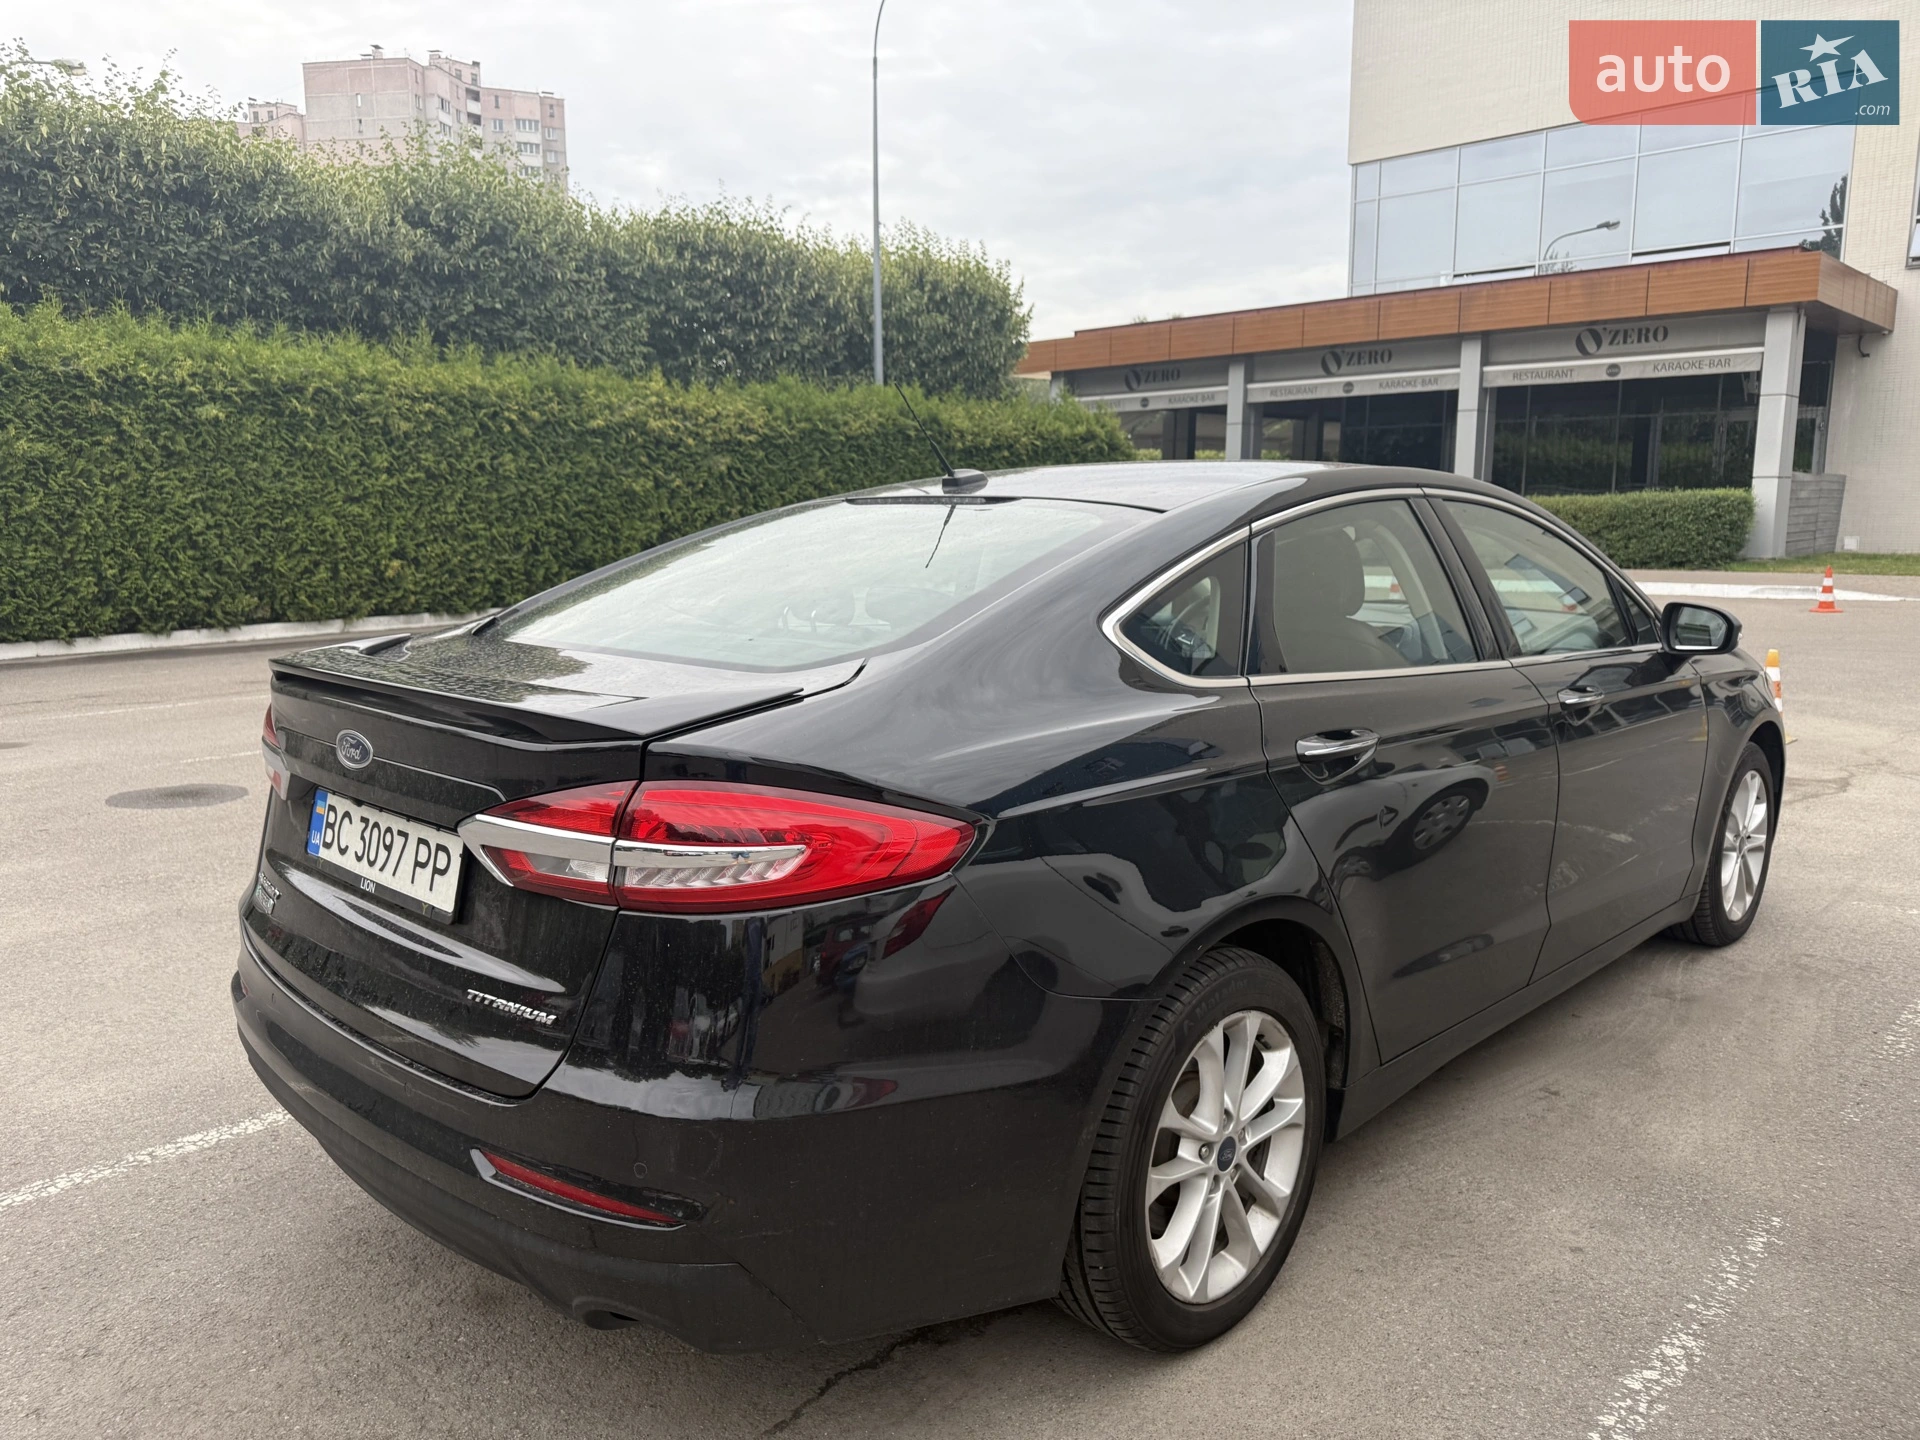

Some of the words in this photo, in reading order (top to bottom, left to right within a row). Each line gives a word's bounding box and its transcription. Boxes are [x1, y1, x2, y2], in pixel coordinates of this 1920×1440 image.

[1512, 368, 1575, 381] RESTAURANT
[1652, 358, 1731, 373] KARAOKE-BAR
[1269, 385, 1318, 398] RESTAURANT
[1378, 378, 1439, 390] KARAOKE-BAR
[341, 736, 363, 761] Ford
[311, 830, 320, 846] UA
[322, 803, 353, 856] BC
[354, 816, 409, 877] 3097
[411, 837, 451, 892] PP
[360, 877, 376, 894] LION
[467, 988, 557, 1025] TITANIUM
